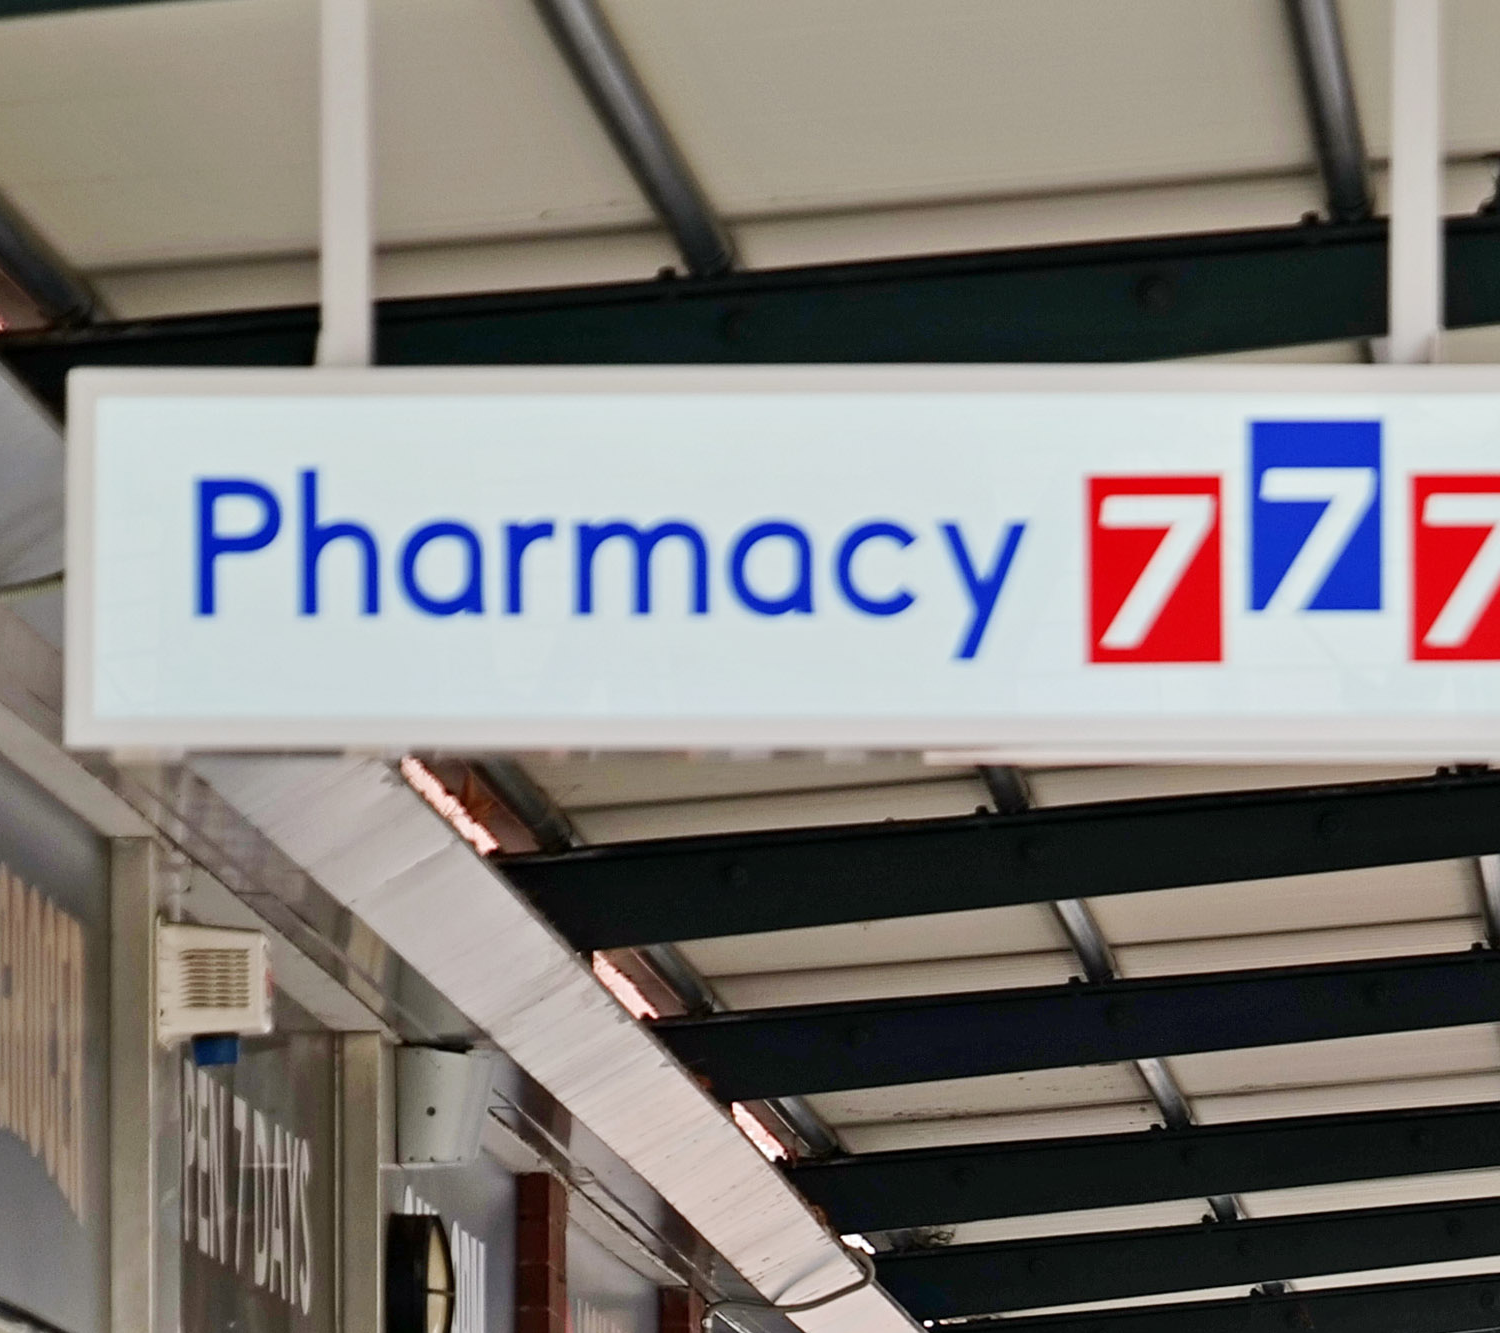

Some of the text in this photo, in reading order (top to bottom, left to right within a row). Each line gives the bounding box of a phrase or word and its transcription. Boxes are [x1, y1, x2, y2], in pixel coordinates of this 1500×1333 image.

[195, 466, 1029, 661] Pharmacy
[182, 1057, 226, 1265] PEN
[233, 1094, 248, 1274] 7
[253, 1108, 312, 1317] DAYS
